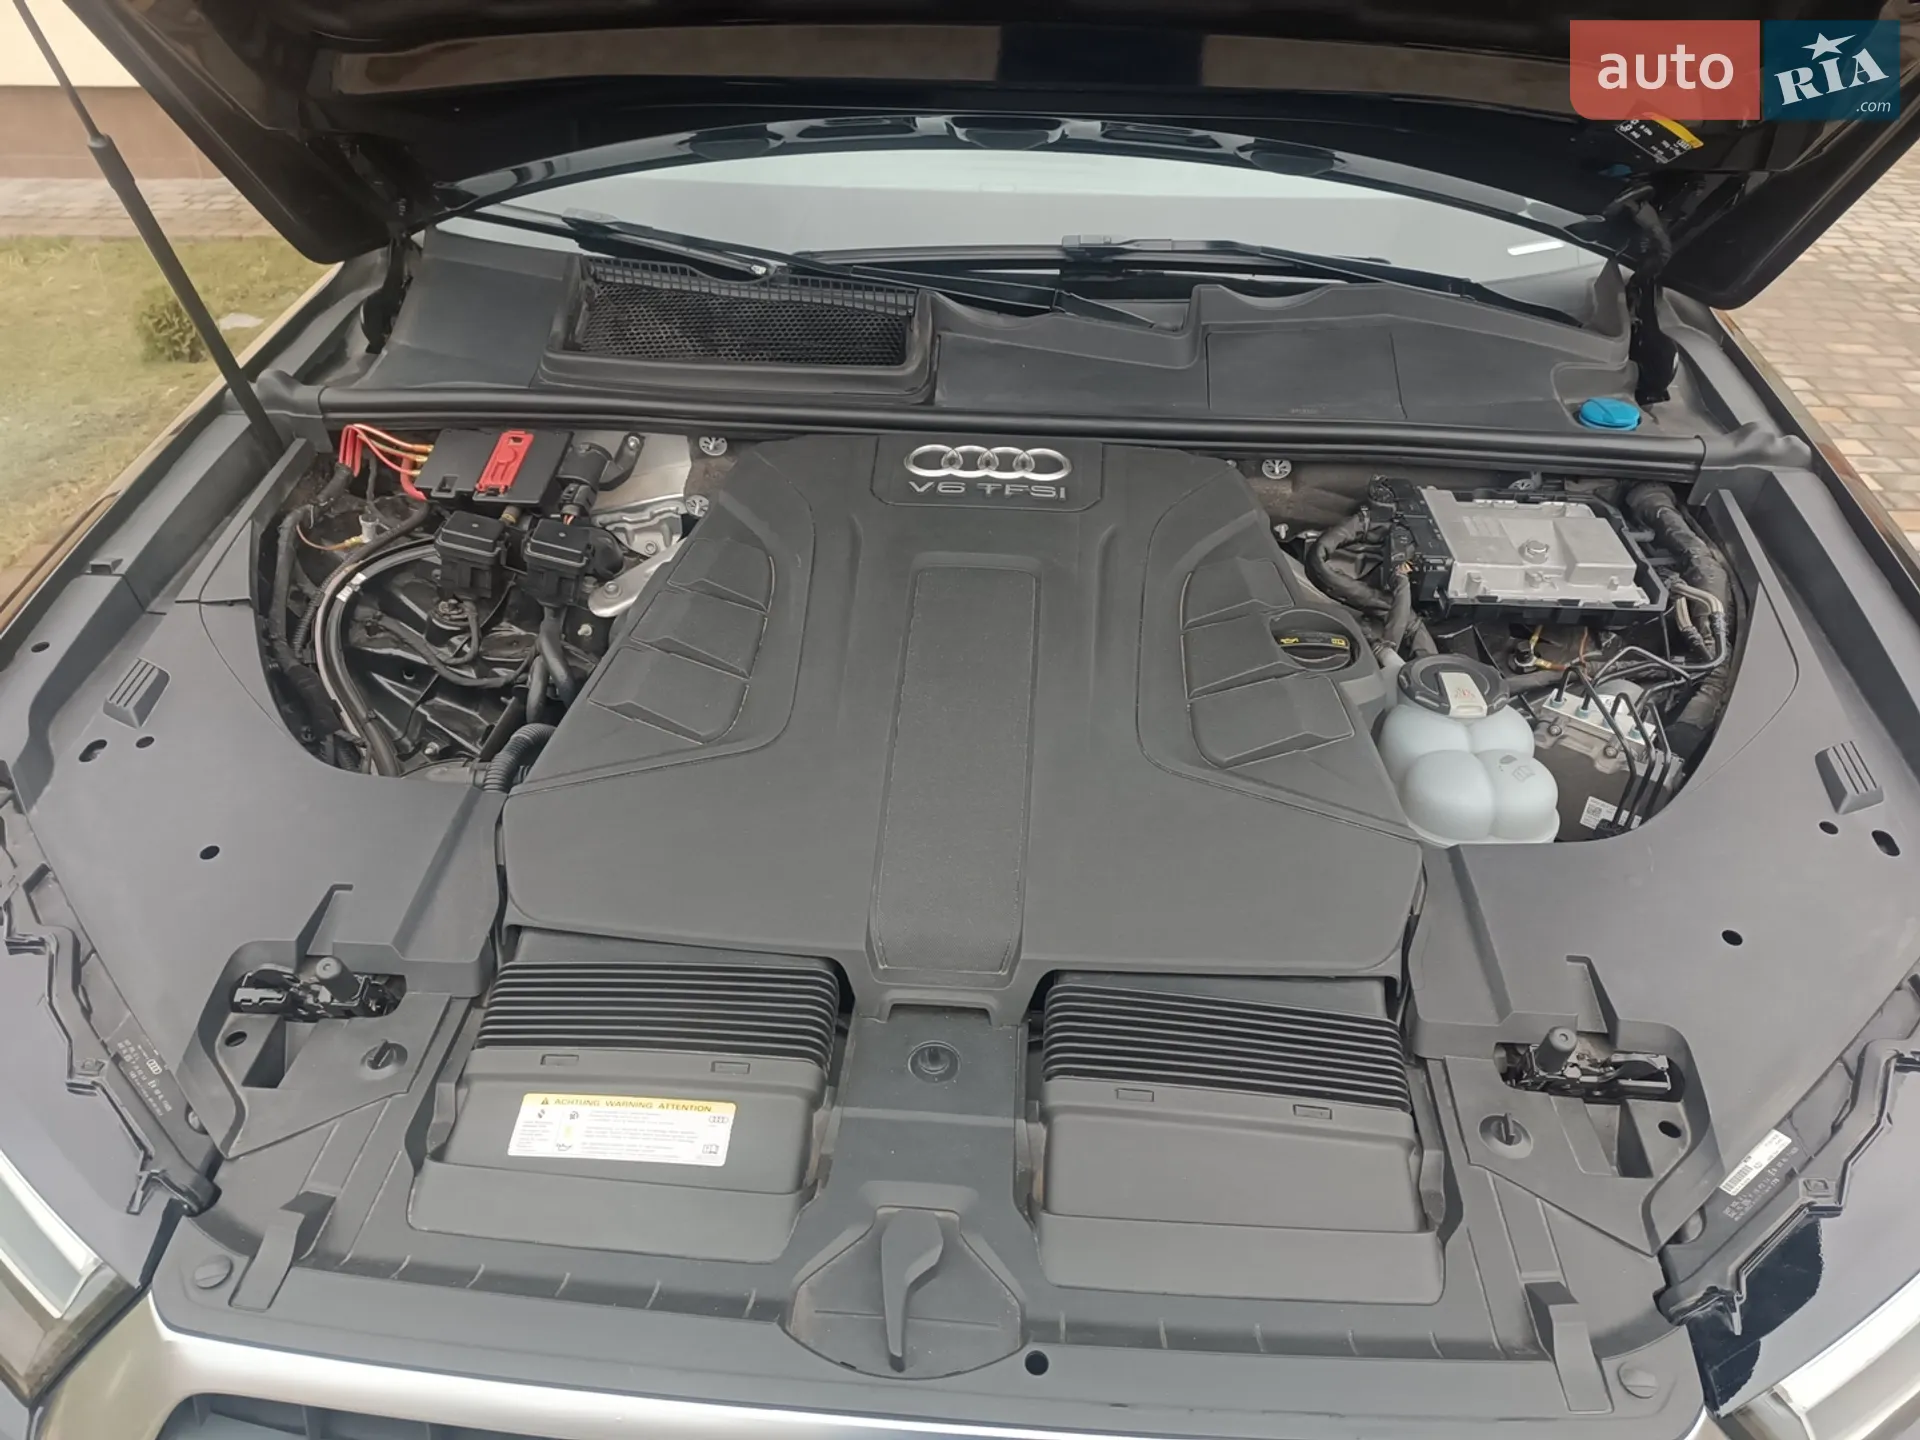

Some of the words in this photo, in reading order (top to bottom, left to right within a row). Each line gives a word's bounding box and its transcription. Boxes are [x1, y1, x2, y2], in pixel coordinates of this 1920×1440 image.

[908, 481, 966, 495] V6
[976, 482, 1067, 500] TFSI
[554, 1098, 600, 1107] ACHTUNG
[605, 1100, 653, 1109] WARNING
[658, 1102, 712, 1112] ATTENTION
